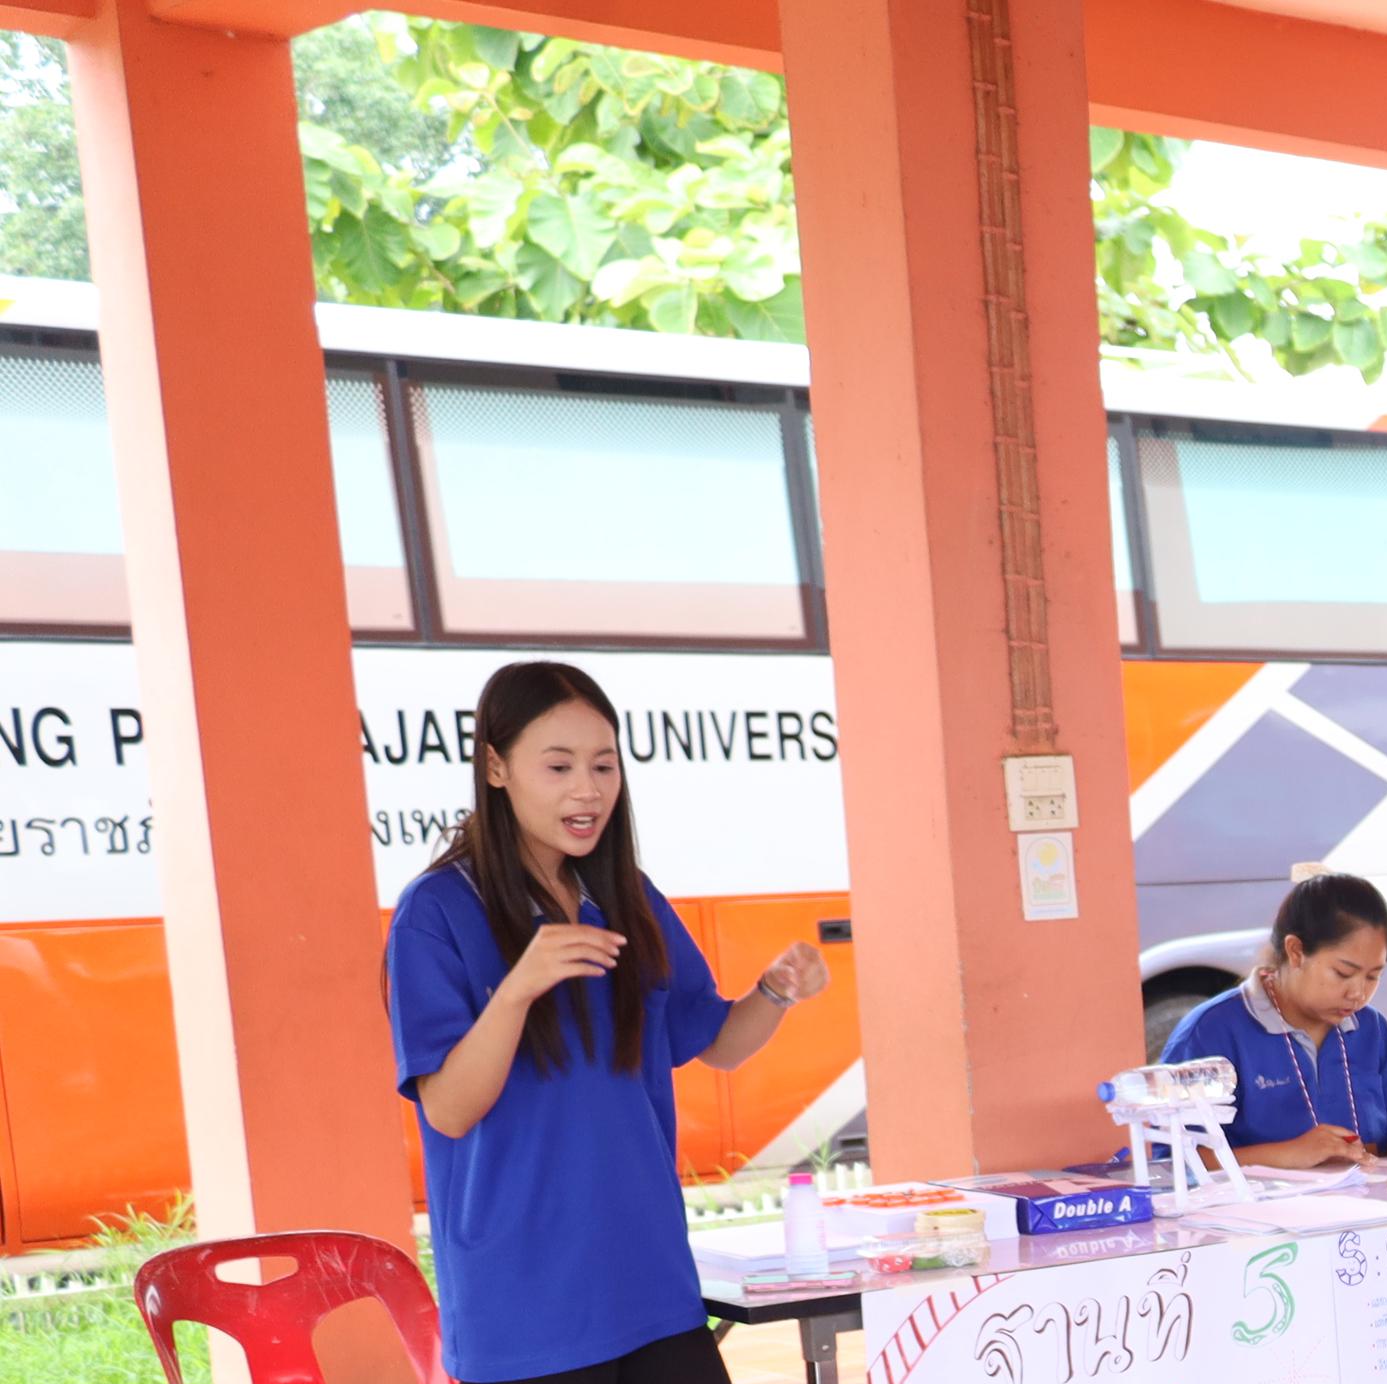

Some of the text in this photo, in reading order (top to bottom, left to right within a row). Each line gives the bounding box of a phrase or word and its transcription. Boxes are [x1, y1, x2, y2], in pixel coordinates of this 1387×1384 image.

[624, 711, 838, 763] UNIVERS
[1053, 1195, 1132, 1219] Double A
[1231, 1241, 1299, 1348] 5
